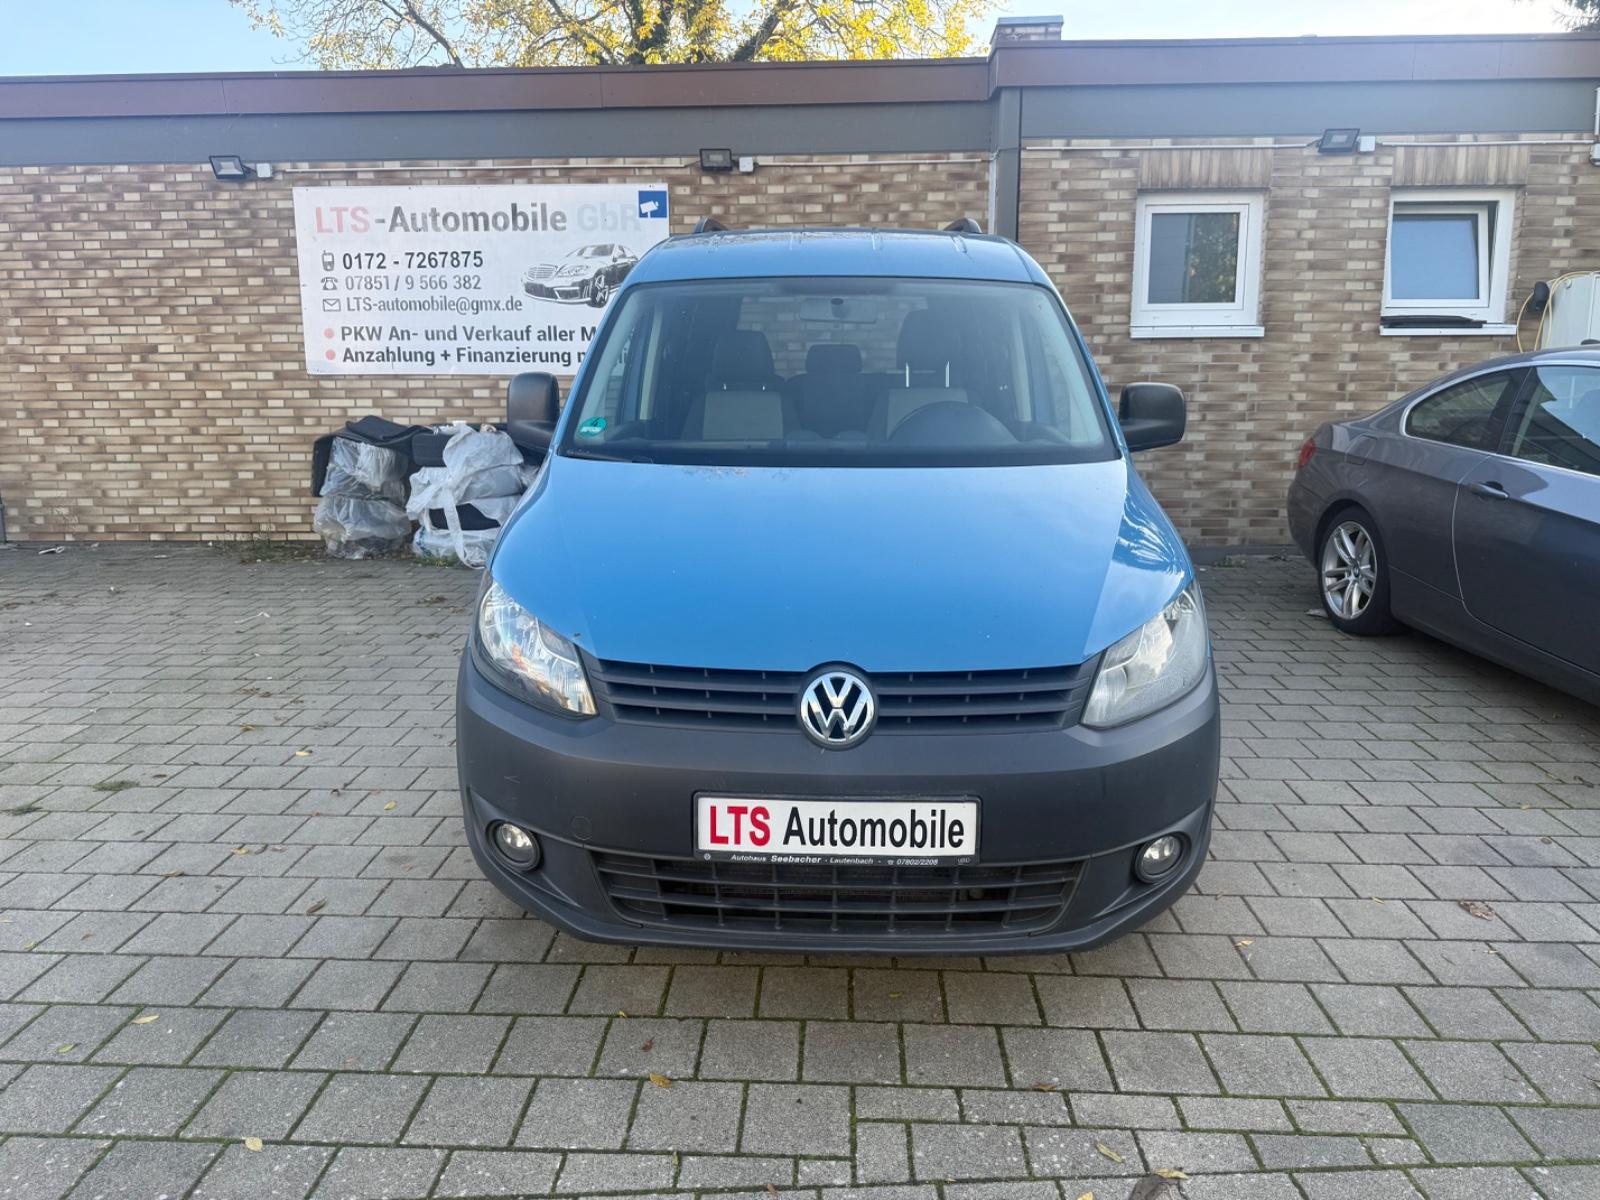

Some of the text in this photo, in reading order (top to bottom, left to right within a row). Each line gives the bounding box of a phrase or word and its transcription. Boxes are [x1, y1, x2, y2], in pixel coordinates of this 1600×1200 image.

[577, 203, 641, 232] GbR
[342, 252, 387, 270] 0172
[404, 251, 484, 269] 7267875
[404, 275, 415, 290] 9
[419, 275, 448, 290] 566
[453, 274, 482, 290] 382
[346, 295, 523, 315] LTS-automobile@gmx.de
[341, 326, 383, 341] PKW
[388, 326, 419, 341] An-
[425, 325, 458, 341] und
[462, 325, 532, 341] Verkauf
[537, 325, 575, 341] aller
[342, 346, 436, 366] Anzahlung
[440, 349, 451, 361] +
[456, 347, 571, 367] Finanzierung
[709, 805, 965, 848] LTS Automobile
[731, 854, 767, 862] Autohaus
[770, 855, 822, 863] Seebacher
[829, 857, 874, 865] Lautenbach
